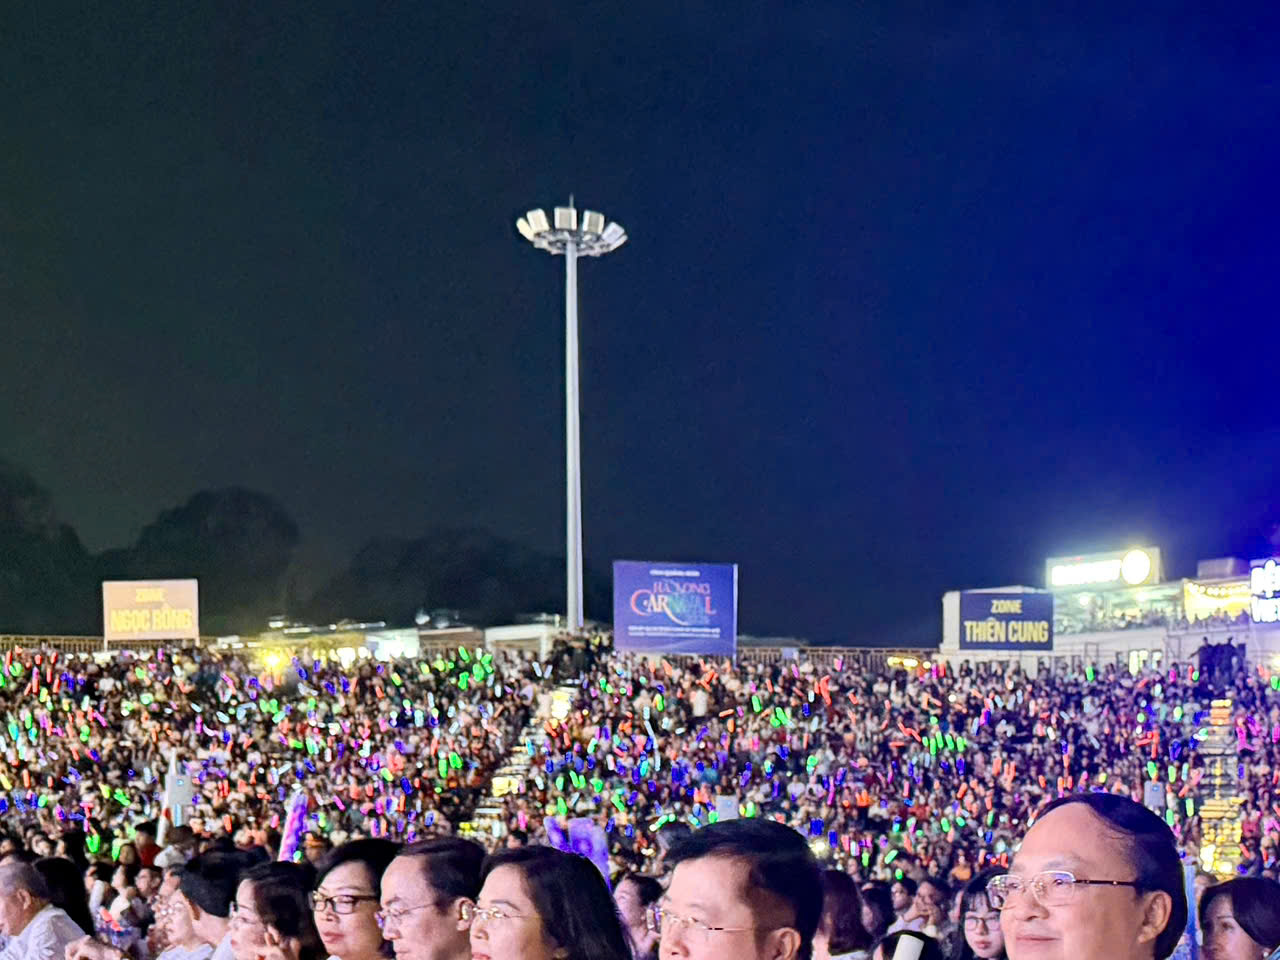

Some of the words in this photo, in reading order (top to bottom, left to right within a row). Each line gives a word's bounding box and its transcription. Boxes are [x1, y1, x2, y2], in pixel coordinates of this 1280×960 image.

[991, 599, 1023, 614] ZONE
[964, 617, 1006, 643] THIÊN
[1008, 620, 1048, 643] CUNG
